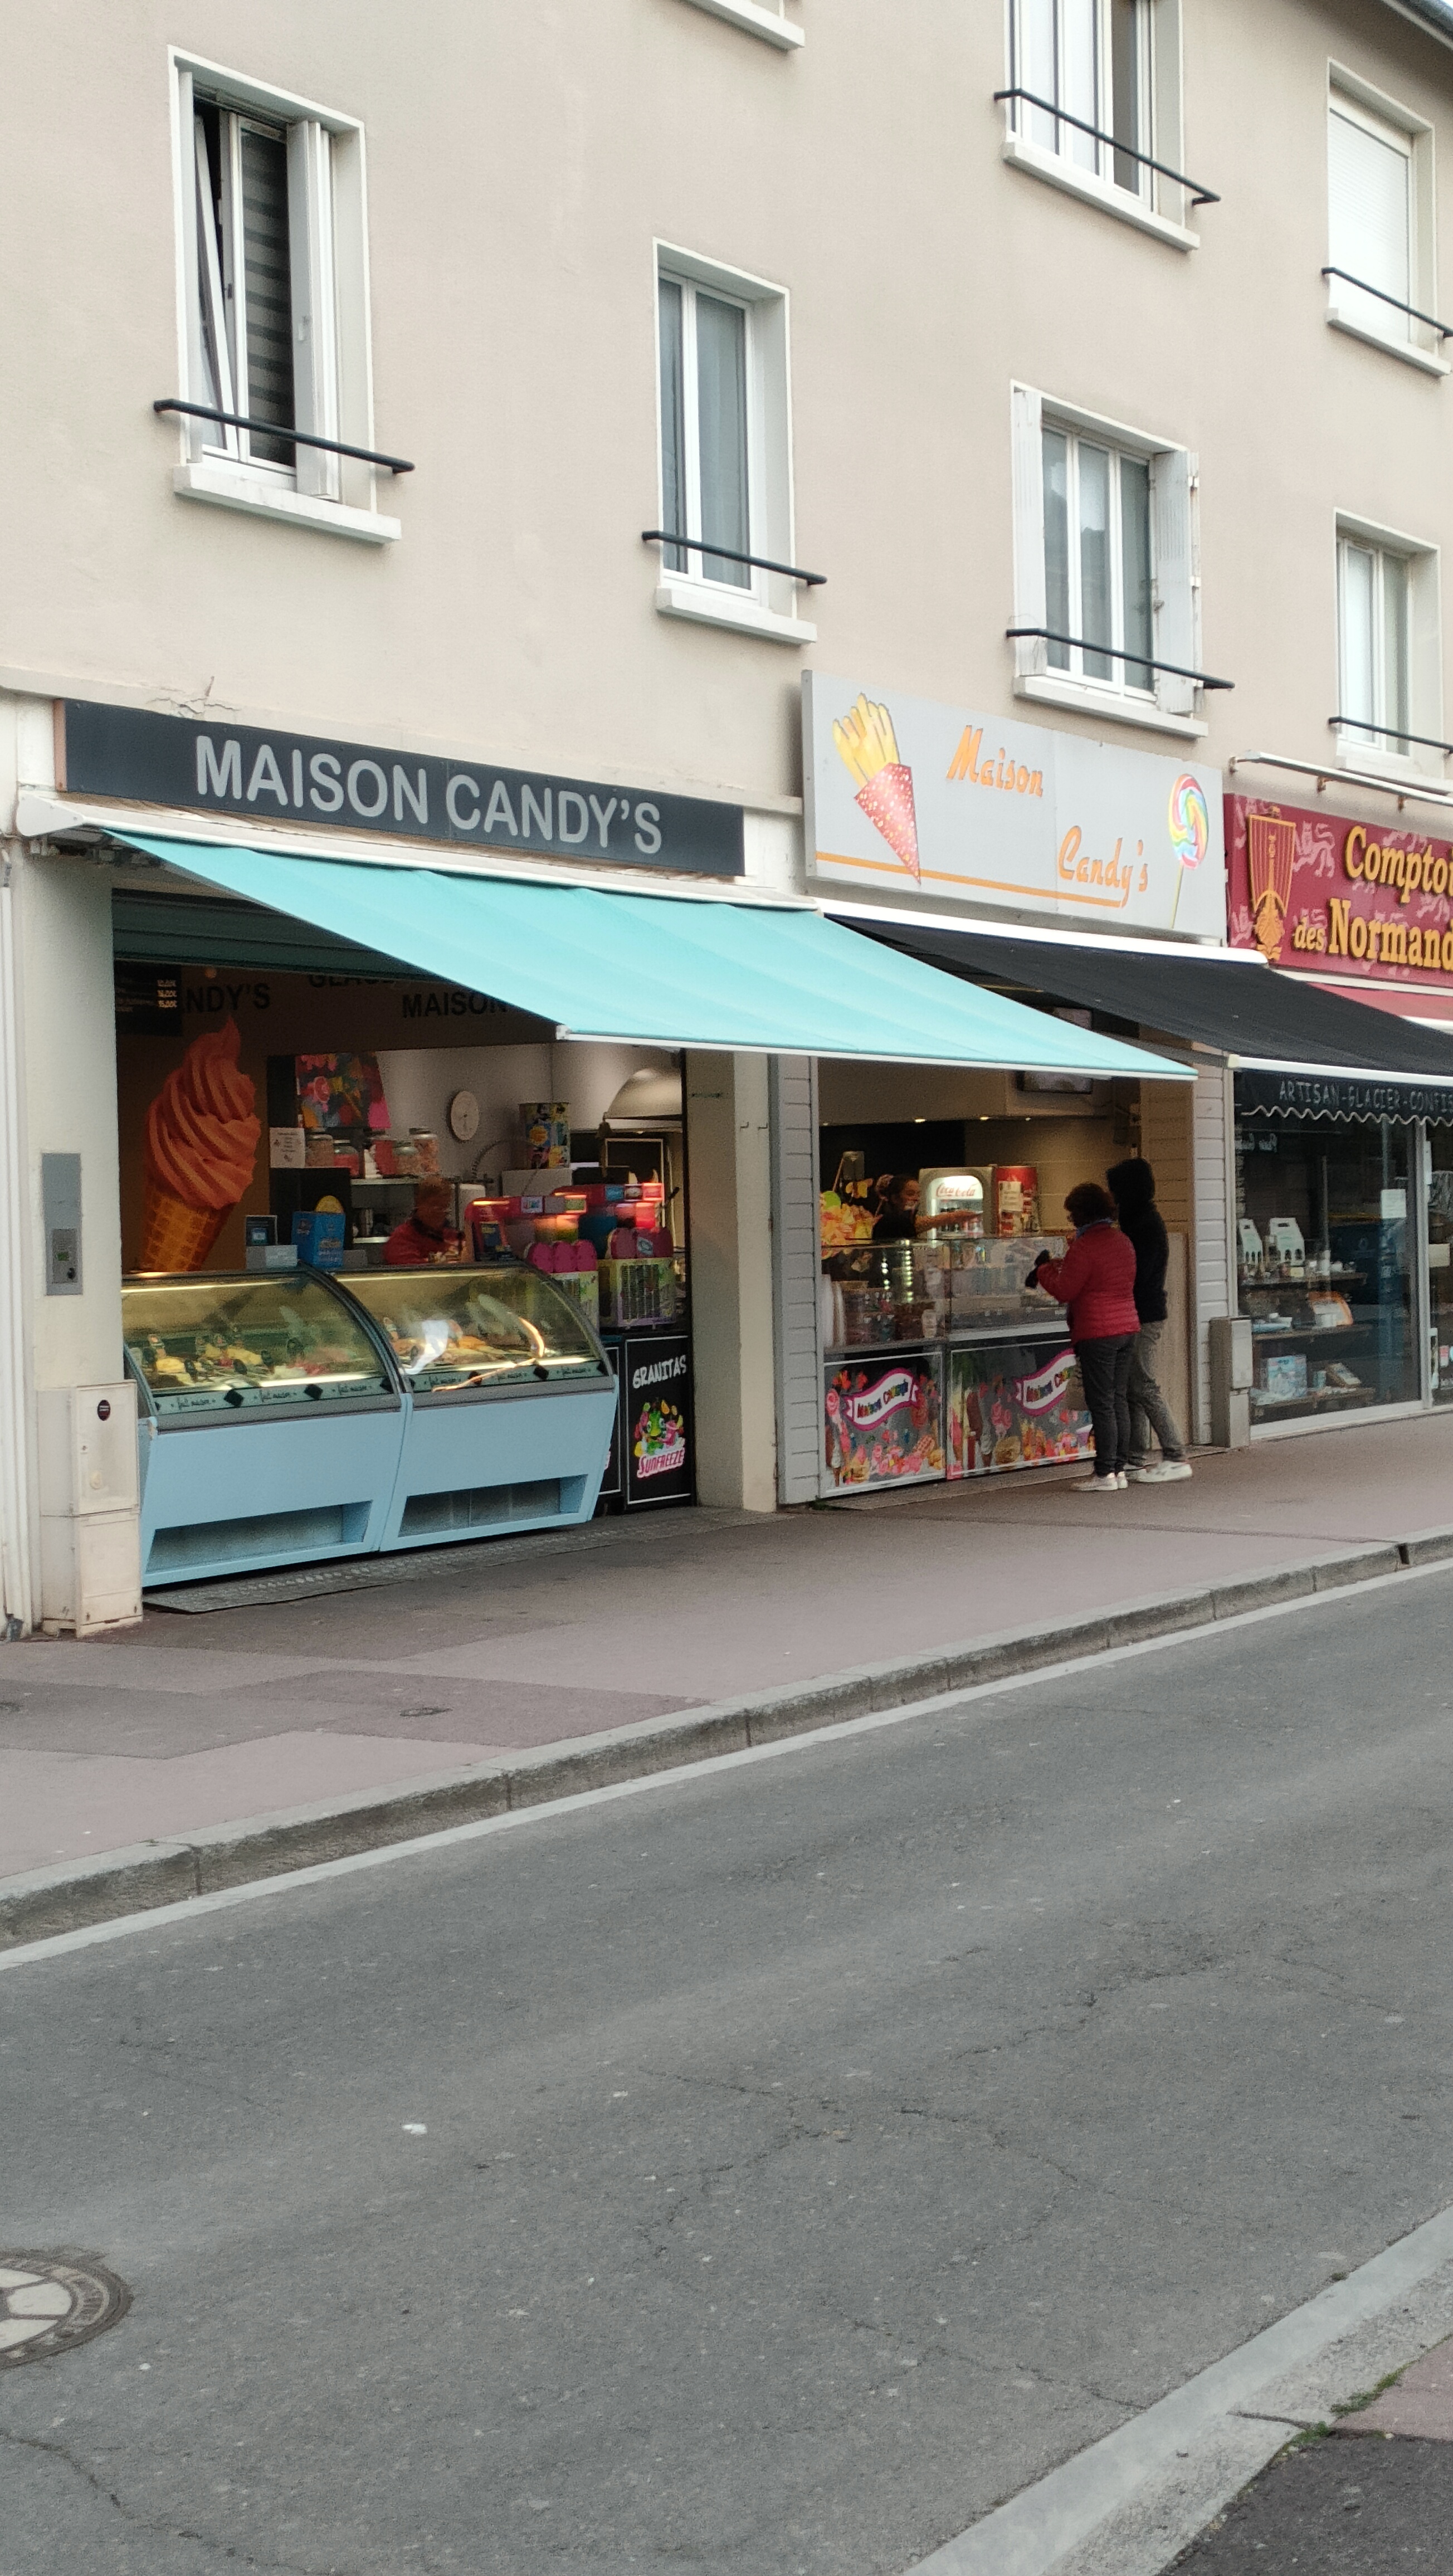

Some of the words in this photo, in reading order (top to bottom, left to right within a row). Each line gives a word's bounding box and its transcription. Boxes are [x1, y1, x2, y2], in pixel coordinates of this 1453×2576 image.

[196, 735, 429, 824] MAISON
[446, 774, 662, 854] CANDY'S
[945, 725, 1043, 798] Maison
[1058, 825, 1148, 908] Candy's
[1293, 915, 1325, 950] des
[632, 1354, 686, 1389] GRANITAS
